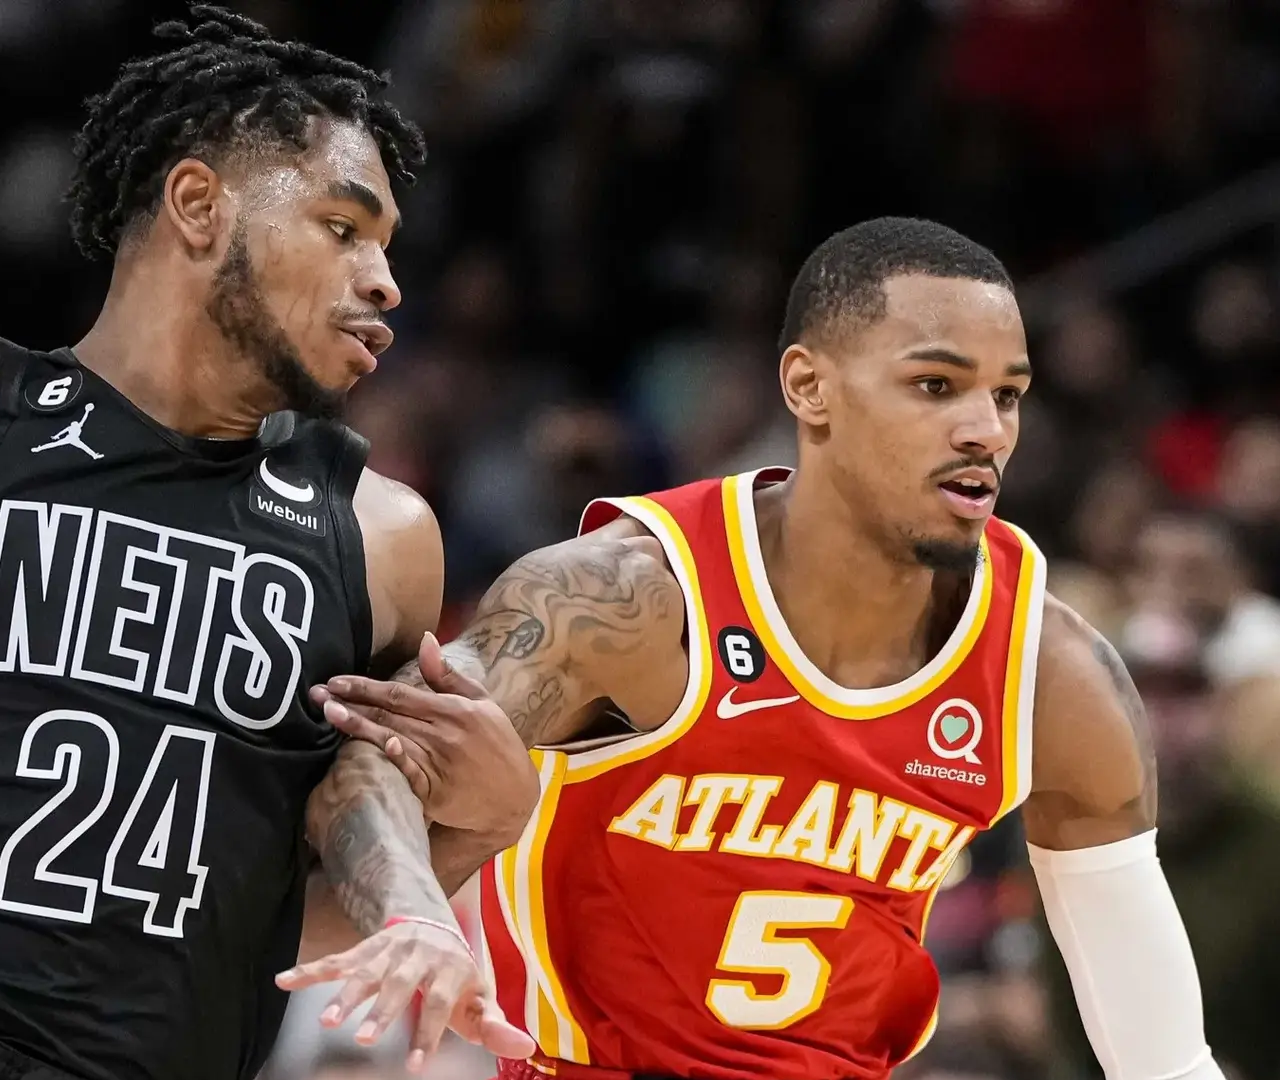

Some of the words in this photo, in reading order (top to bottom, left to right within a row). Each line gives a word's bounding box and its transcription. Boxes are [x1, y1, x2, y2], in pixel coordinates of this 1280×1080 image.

[38, 376, 73, 406] 6
[256, 494, 319, 531] Webull
[725, 634, 754, 676] 6
[904, 759, 987, 786] sharecare
[704, 890, 855, 1032] 5
